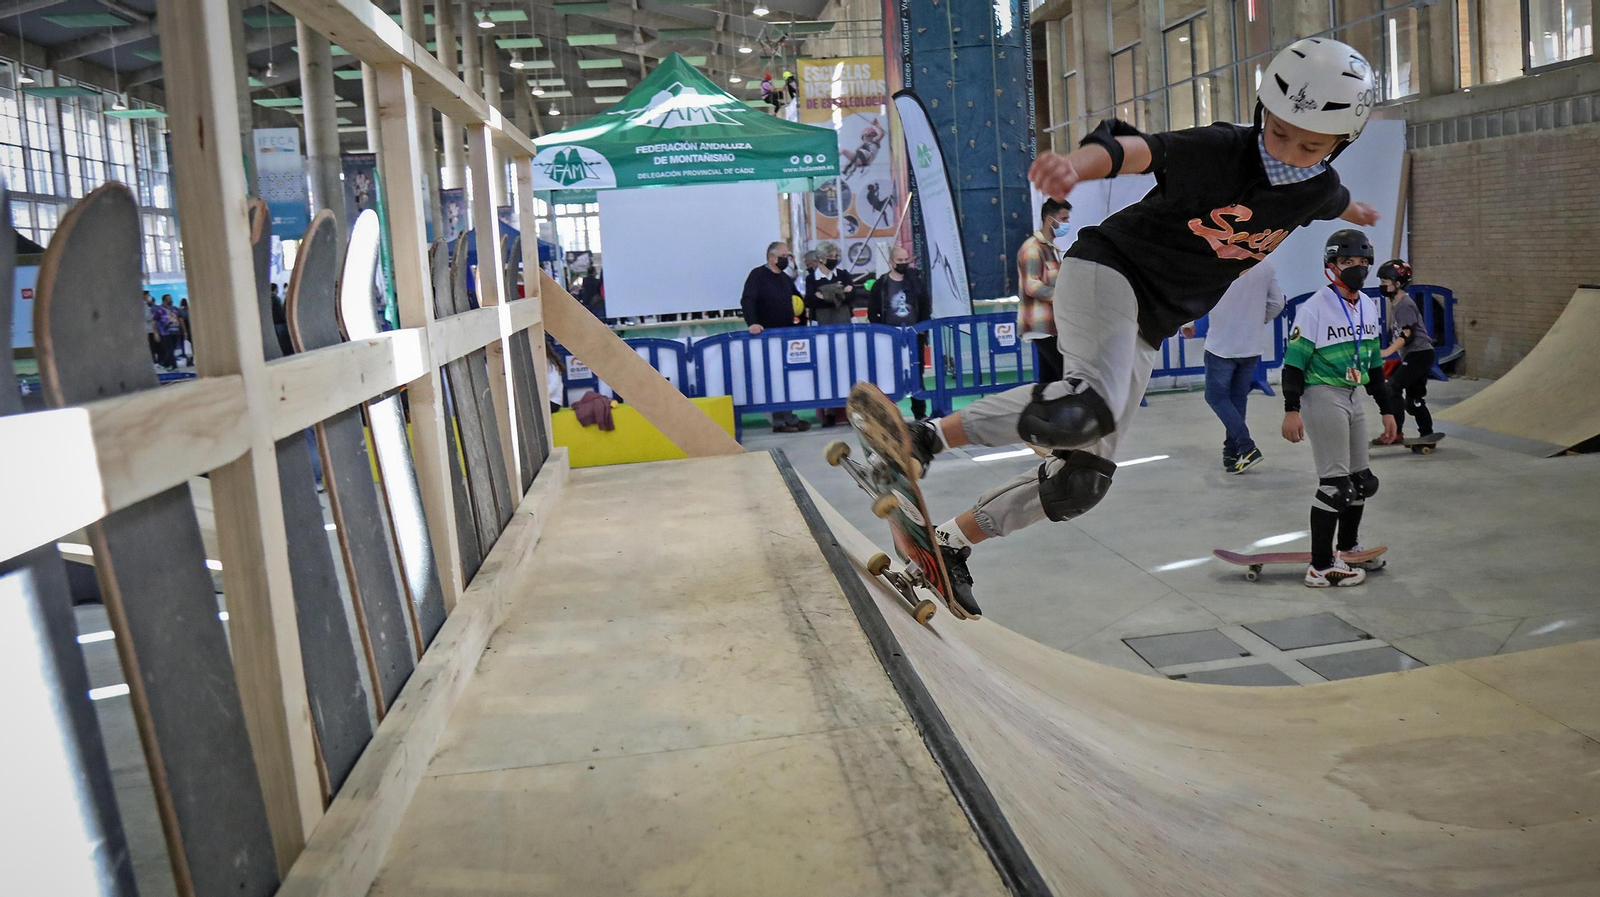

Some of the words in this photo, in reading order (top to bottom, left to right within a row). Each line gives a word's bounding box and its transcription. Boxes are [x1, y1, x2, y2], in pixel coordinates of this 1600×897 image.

[902, 18, 911, 56] Windsurf
[1025, 28, 1033, 80] Cicloturismo
[805, 79, 886, 98] DEPRTIVAS
[806, 98, 819, 110] DE
[258, 136, 295, 146] IFECA
[635, 141, 698, 154] FEDERACIÓN
[699, 142, 753, 151] ANDALUZA
[653, 156, 668, 165] DE
[669, 152, 735, 164] MONTAÑISMO
[553, 164, 584, 185] FAM
[637, 170, 682, 180] DELEGACIÓN
[682, 168, 723, 177] PROVINCIAL
[724, 167, 733, 175] DE
